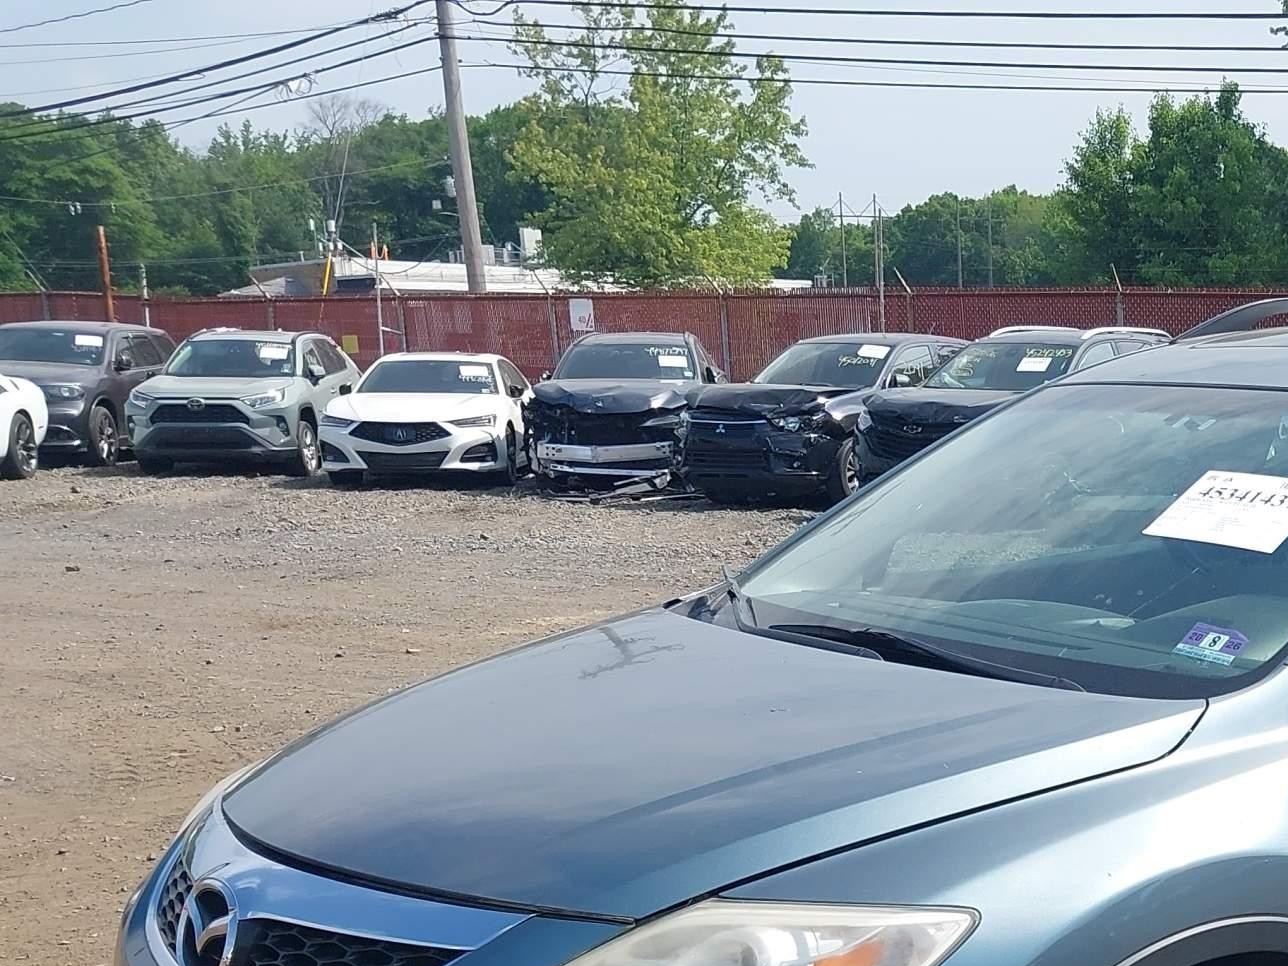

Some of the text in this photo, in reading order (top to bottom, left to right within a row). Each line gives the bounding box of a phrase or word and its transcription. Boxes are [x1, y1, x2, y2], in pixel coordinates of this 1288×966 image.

[1188, 631, 1242, 651] 20 8 26
